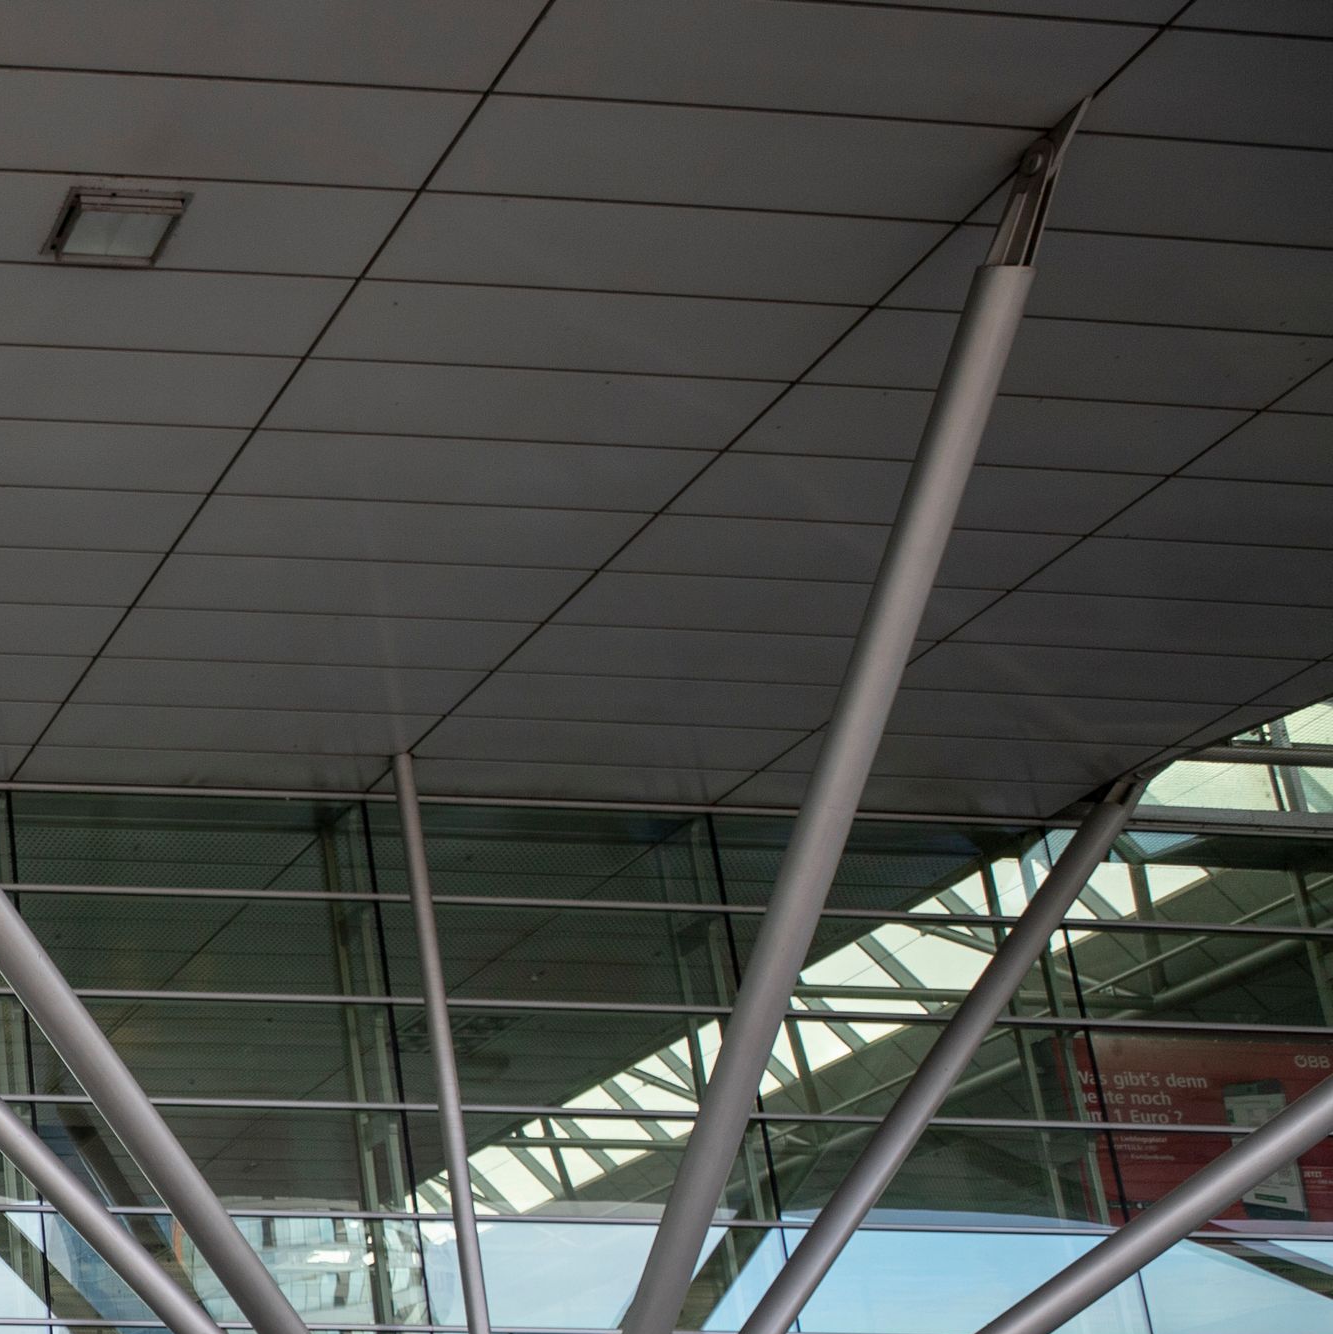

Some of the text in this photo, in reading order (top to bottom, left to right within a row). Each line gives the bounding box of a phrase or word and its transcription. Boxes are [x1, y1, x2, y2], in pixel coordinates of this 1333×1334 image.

[1113, 1071, 1161, 1089] gibt's
[1165, 1073, 1208, 1089] denn
[1130, 1091, 1172, 1106] noch
